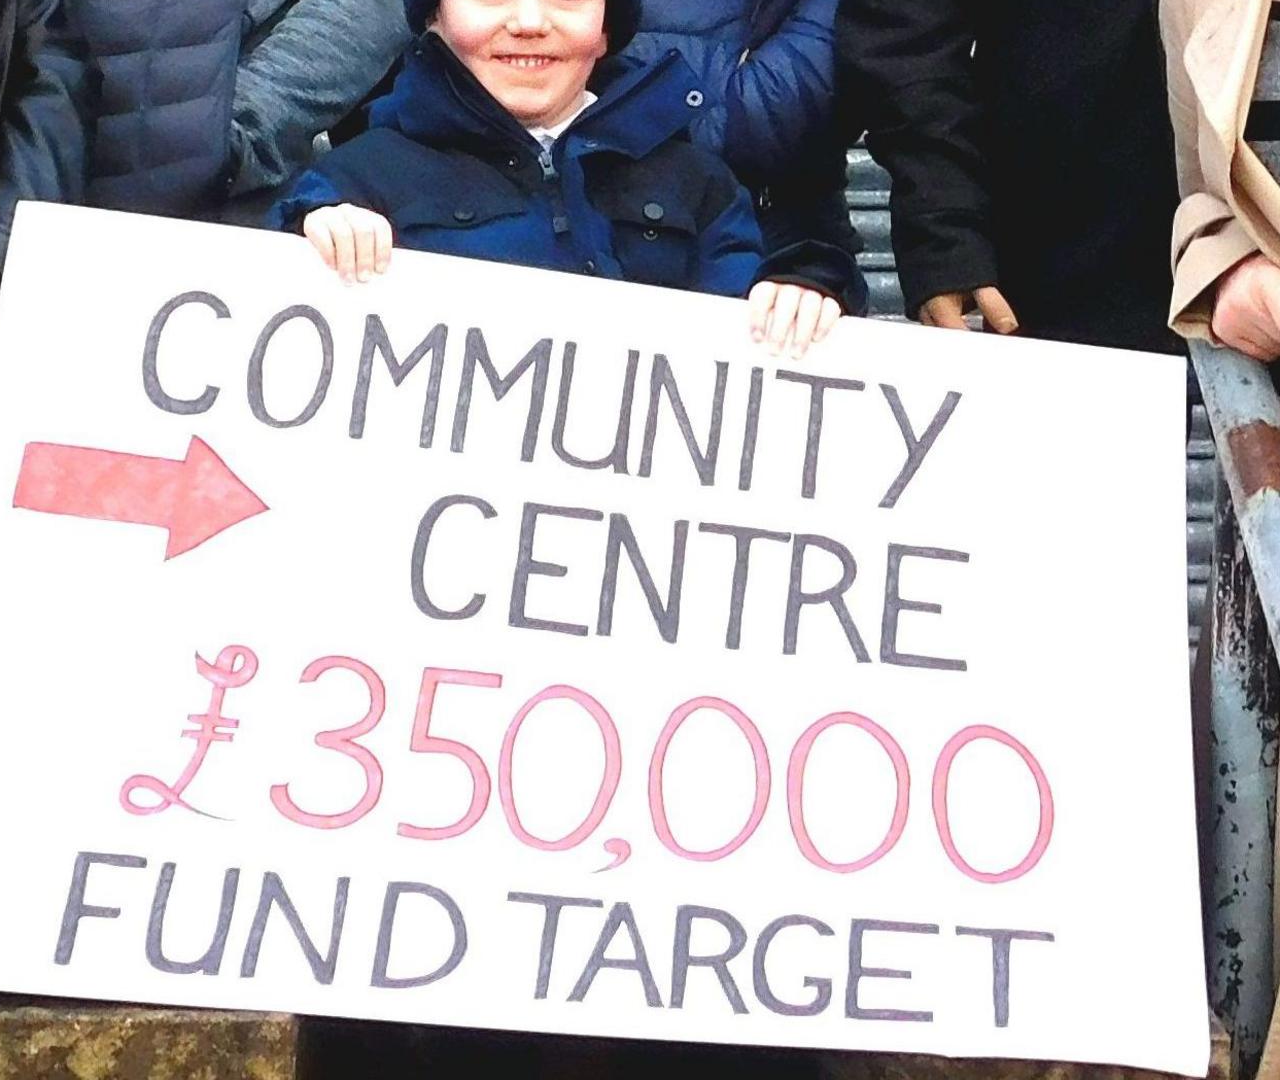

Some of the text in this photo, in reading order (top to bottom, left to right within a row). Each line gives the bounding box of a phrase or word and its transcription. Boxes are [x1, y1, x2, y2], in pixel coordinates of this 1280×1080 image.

[140, 289, 963, 511] COMMUNITY
[409, 493, 971, 672] CENTRE
[119, 643, 1056, 886] £350,000
[53, 851, 1056, 1030] FUND TARGET
